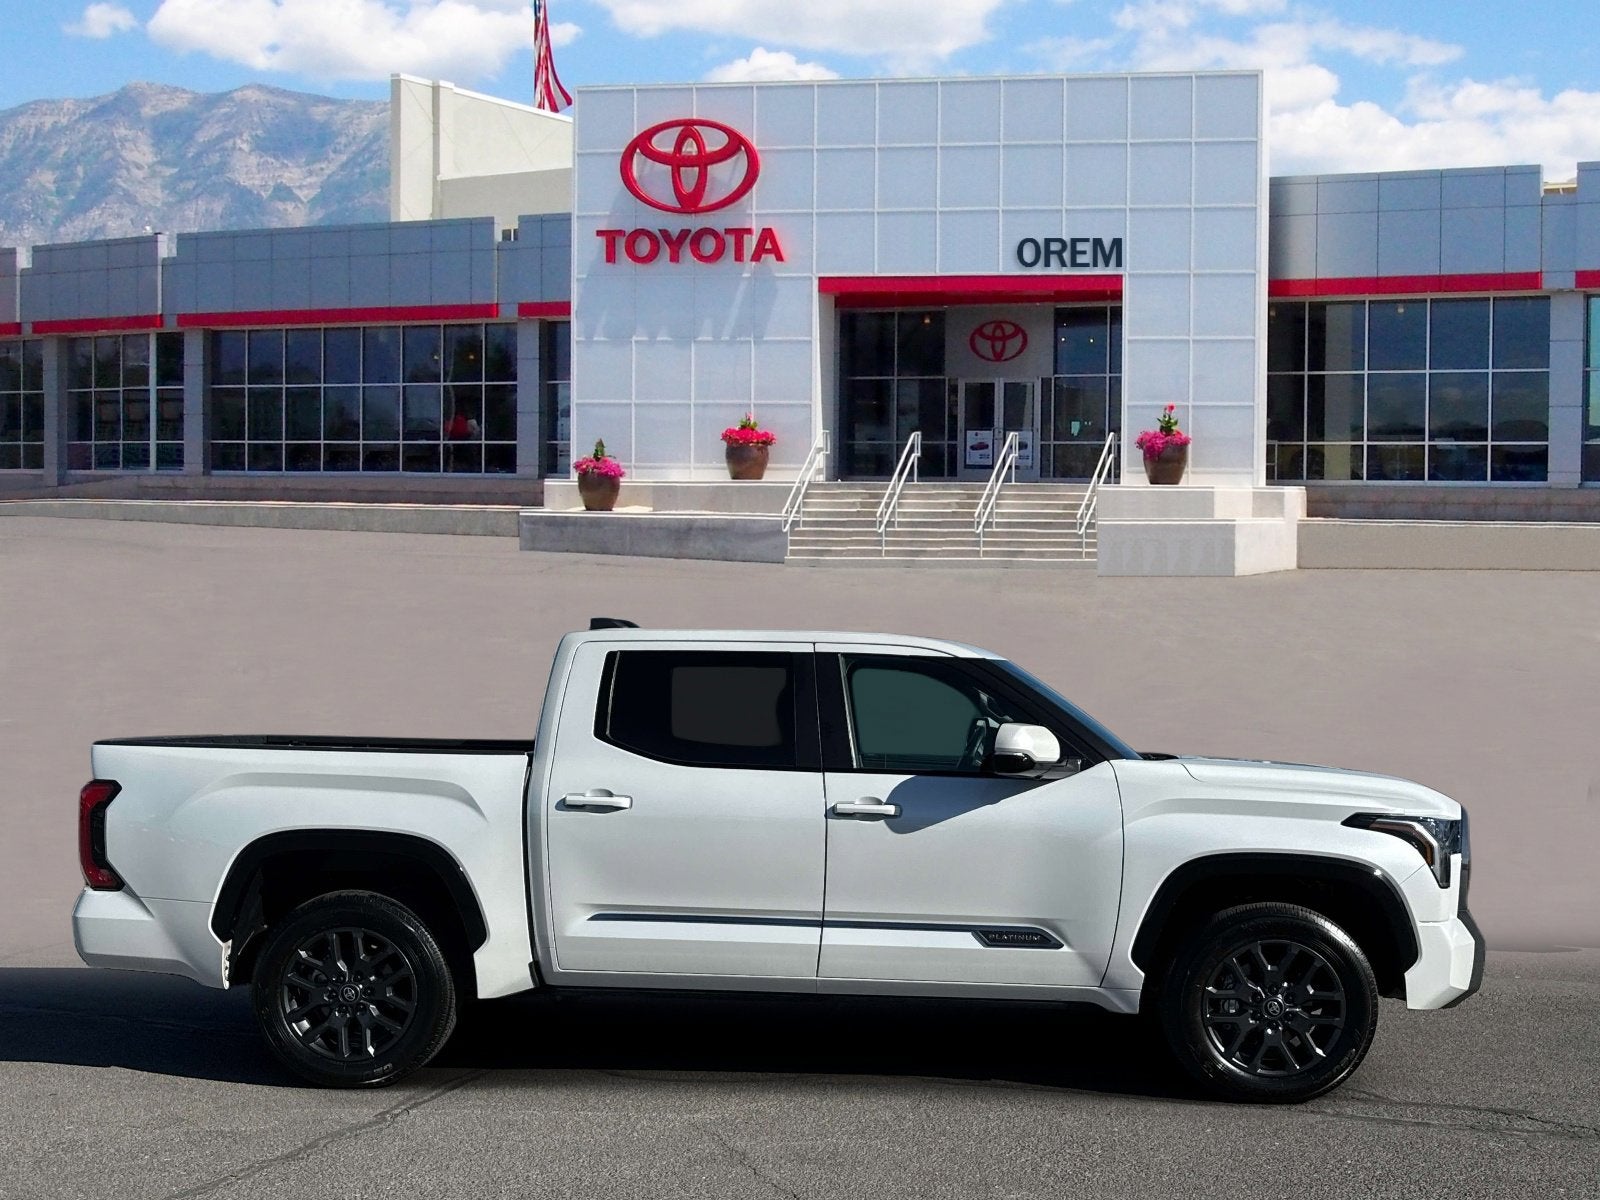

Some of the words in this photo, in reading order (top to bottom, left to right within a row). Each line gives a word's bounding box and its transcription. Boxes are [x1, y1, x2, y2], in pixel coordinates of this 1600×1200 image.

[596, 227, 784, 264] TOYOTA
[1017, 237, 1122, 268] OREM
[988, 933, 1041, 941] PLATINUM
